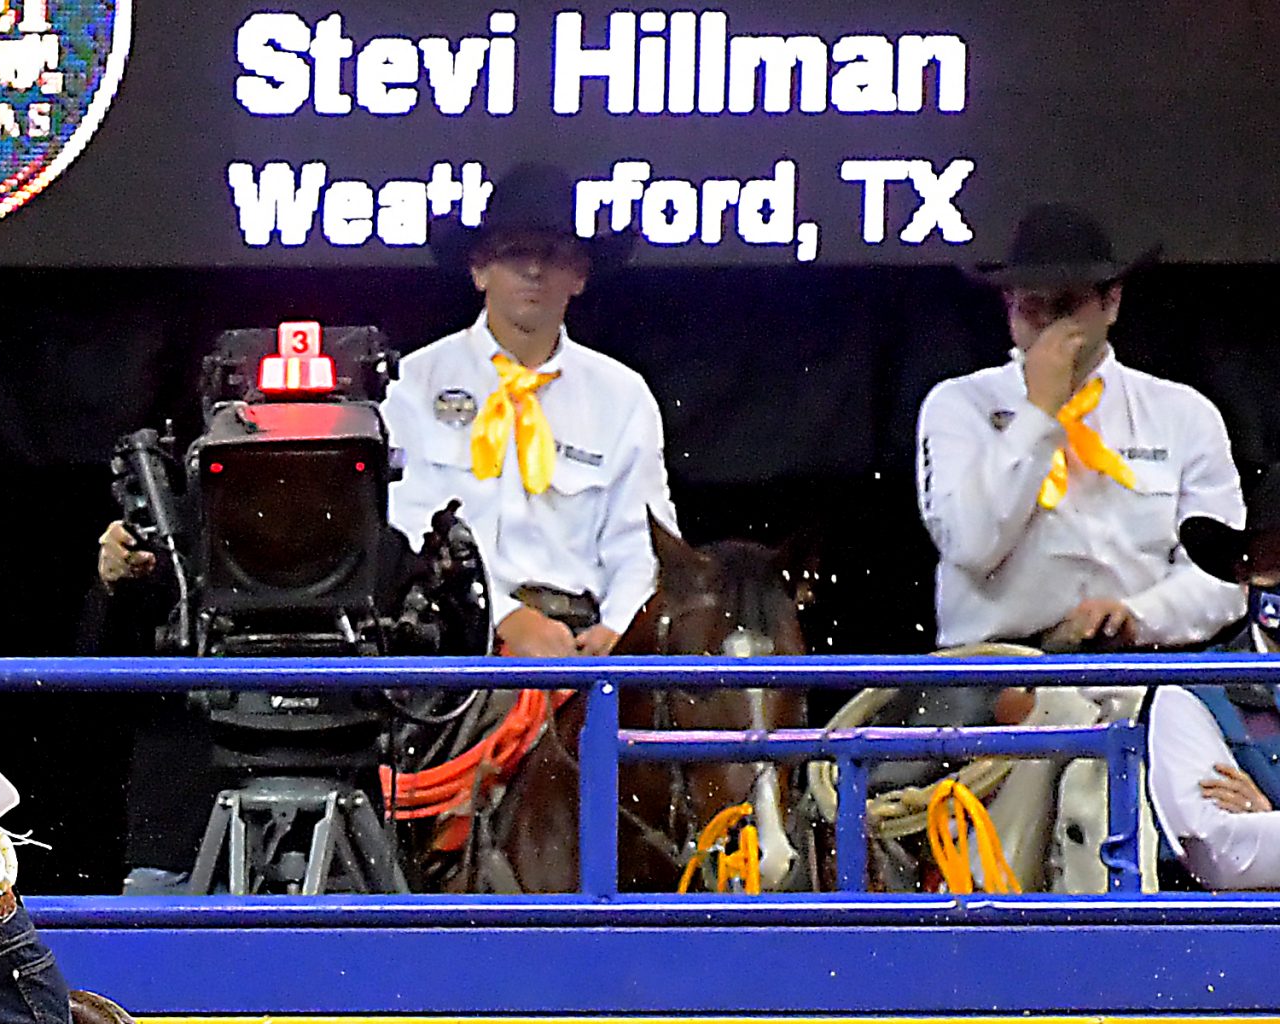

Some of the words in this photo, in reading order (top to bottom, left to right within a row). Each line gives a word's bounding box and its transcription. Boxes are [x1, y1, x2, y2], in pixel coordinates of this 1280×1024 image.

[236, 11, 516, 115] Stevi
[552, 11, 967, 114] Hillman
[840, 159, 975, 243] TX
[292, 330, 309, 354] 3
